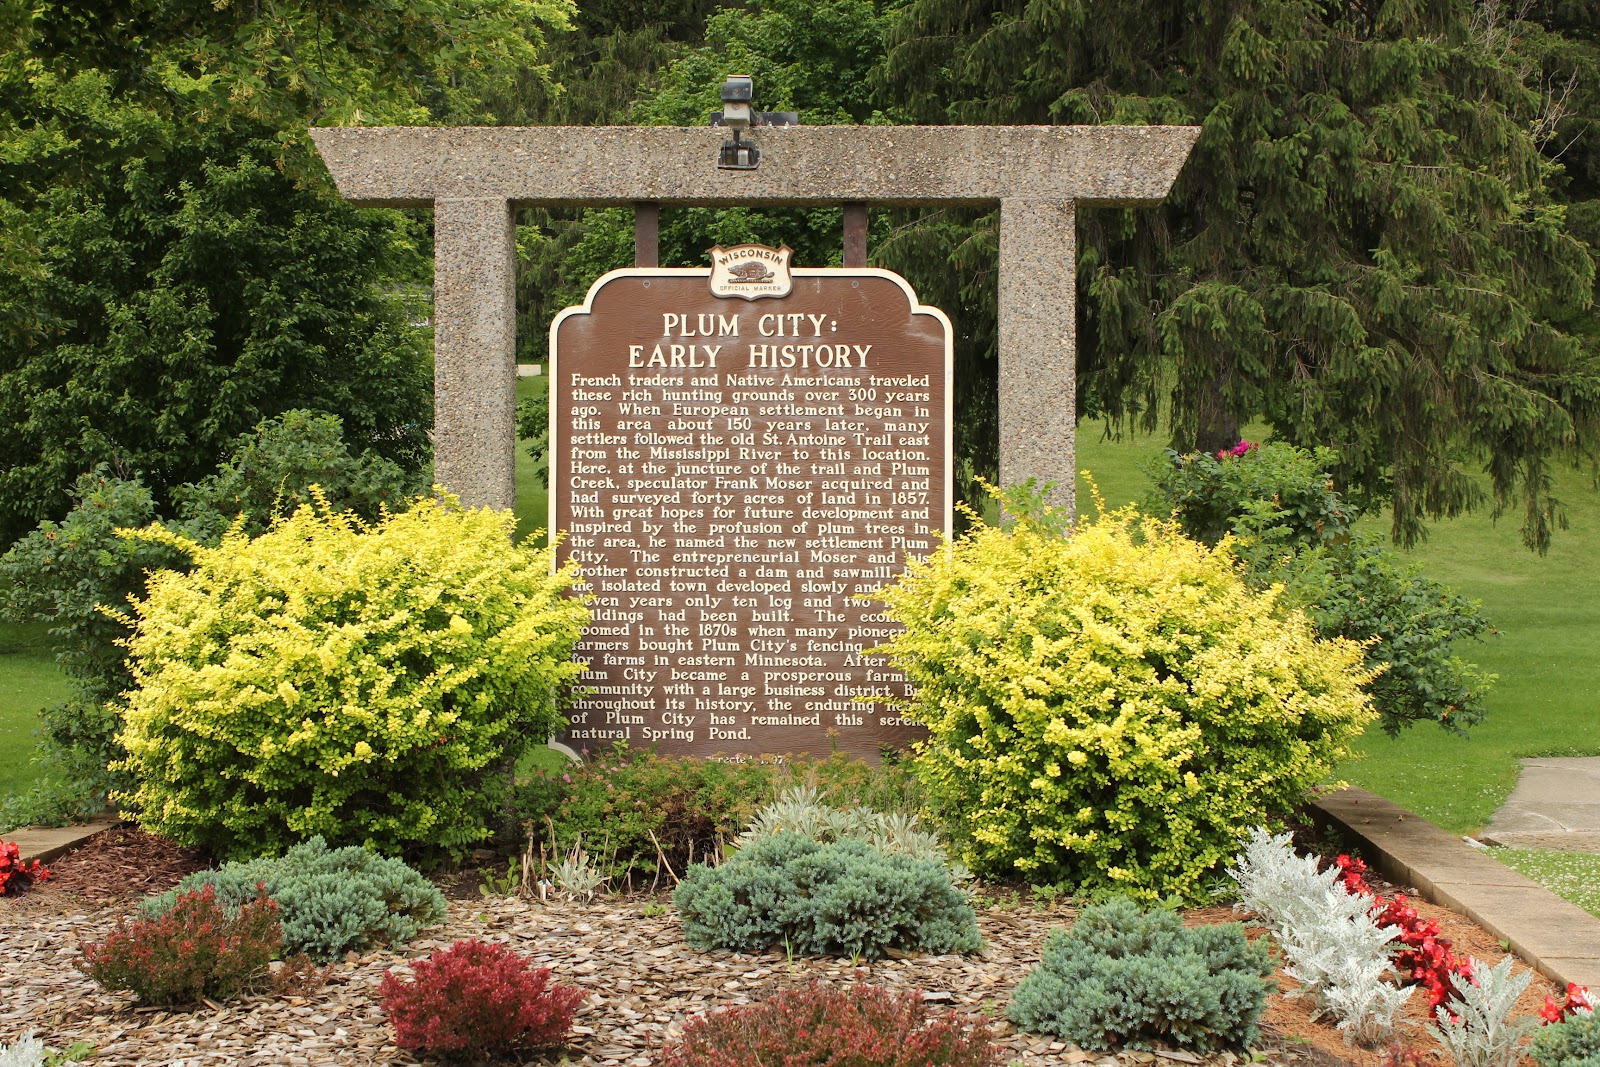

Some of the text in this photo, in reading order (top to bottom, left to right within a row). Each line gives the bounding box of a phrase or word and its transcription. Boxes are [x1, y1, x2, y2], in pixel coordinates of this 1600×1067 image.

[719, 249, 783, 265] WISCONSIN
[662, 312, 838, 337] PLUM CITY:
[628, 344, 873, 368] EARLY HISTORY
[571, 373, 930, 387] French traders and Native Americans traveled
[571, 388, 930, 404] these rich hunting grounds over 300 years
[571, 403, 929, 419] ago. When European settlement began in
[571, 417, 930, 434] this area about 150 years later, many
[570, 432, 930, 445] settlers followed the old St. Antoine Trail east
[570, 446, 930, 463] from the Mississippi River to this location.
[570, 461, 930, 478] Here, at the juncture of the trail and Plum
[570, 476, 930, 492] Creek, speculator Frank Moser acquired and
[570, 490, 930, 507] had surveyed forty acres of land in 1857.
[572, 505, 929, 522] With great hopes for future development and
[570, 520, 929, 536] inspired by the profusion of plum trees in
[570, 534, 929, 551] the area, he named the new settlement Plum
[634, 549, 896, 566] The entrepreneurial Moser and
[636, 564, 824, 577] constructed a dam and
[601, 579, 848, 595] isolated town developed slowly
[629, 593, 832, 610] years only ten log and
[658, 608, 846, 621] had been built. The
[639, 623, 839, 639] in the 1870s when many
[638, 637, 694, 653] bought
[702, 637, 741, 650] Plum
[750, 637, 797, 654] City's
[806, 637, 863, 654] fencing
[602, 652, 646, 665] farms
[654, 652, 670, 665] in
[678, 652, 736, 665] eastern
[745, 652, 827, 665] Minnesota.
[844, 652, 887, 665] After
[623, 667, 852, 683] City became a prosperous
[662, 681, 695, 694] with
[702, 685, 711, 694] a
[718, 681, 757, 698] large
[764, 681, 825, 694] business
[666, 696, 792, 712] its history, the
[571, 710, 863, 727] of Plum City has remained this
[572, 725, 751, 741] natural Spring Pond.
